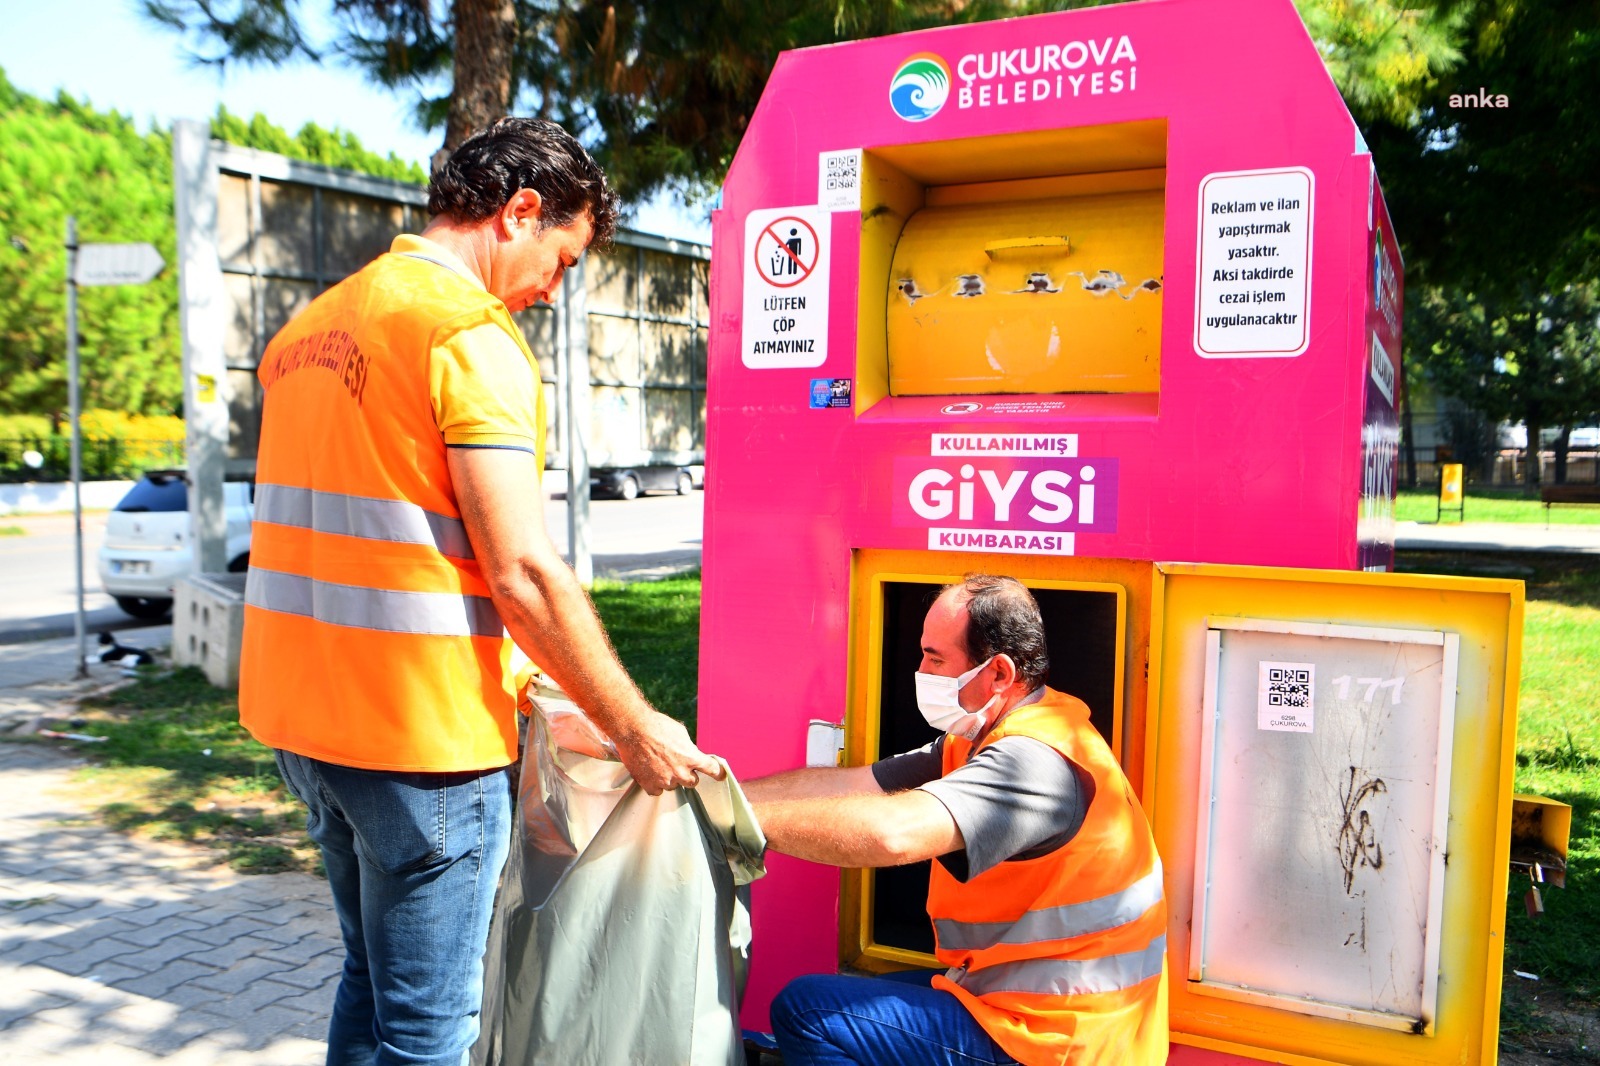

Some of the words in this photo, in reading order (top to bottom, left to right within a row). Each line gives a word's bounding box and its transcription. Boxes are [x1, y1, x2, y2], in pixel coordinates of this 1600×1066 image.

[957, 35, 1137, 88] ÇUKUROVA
[958, 66, 1137, 109] BELEDİYESİ
[1211, 201, 1256, 215] Reklam
[1260, 201, 1274, 212] ve
[1277, 198, 1300, 210] ilan
[1218, 221, 1291, 238] yapıştırmak
[1228, 245, 1280, 260] yasaktır.
[1213, 269, 1238, 282] Aksi
[1241, 267, 1294, 281] takdirde
[764, 295, 806, 311] LÜTFEN
[1219, 291, 1249, 304] cezai
[1252, 290, 1286, 305] işlem
[773, 316, 796, 335] ÇÖP
[1206, 312, 1298, 328] uygulanacaktır
[753, 339, 815, 355] ATMAYINIZ
[940, 438, 1068, 455] KULLANILMIŞ
[939, 532, 1062, 551] KUMBARASI
